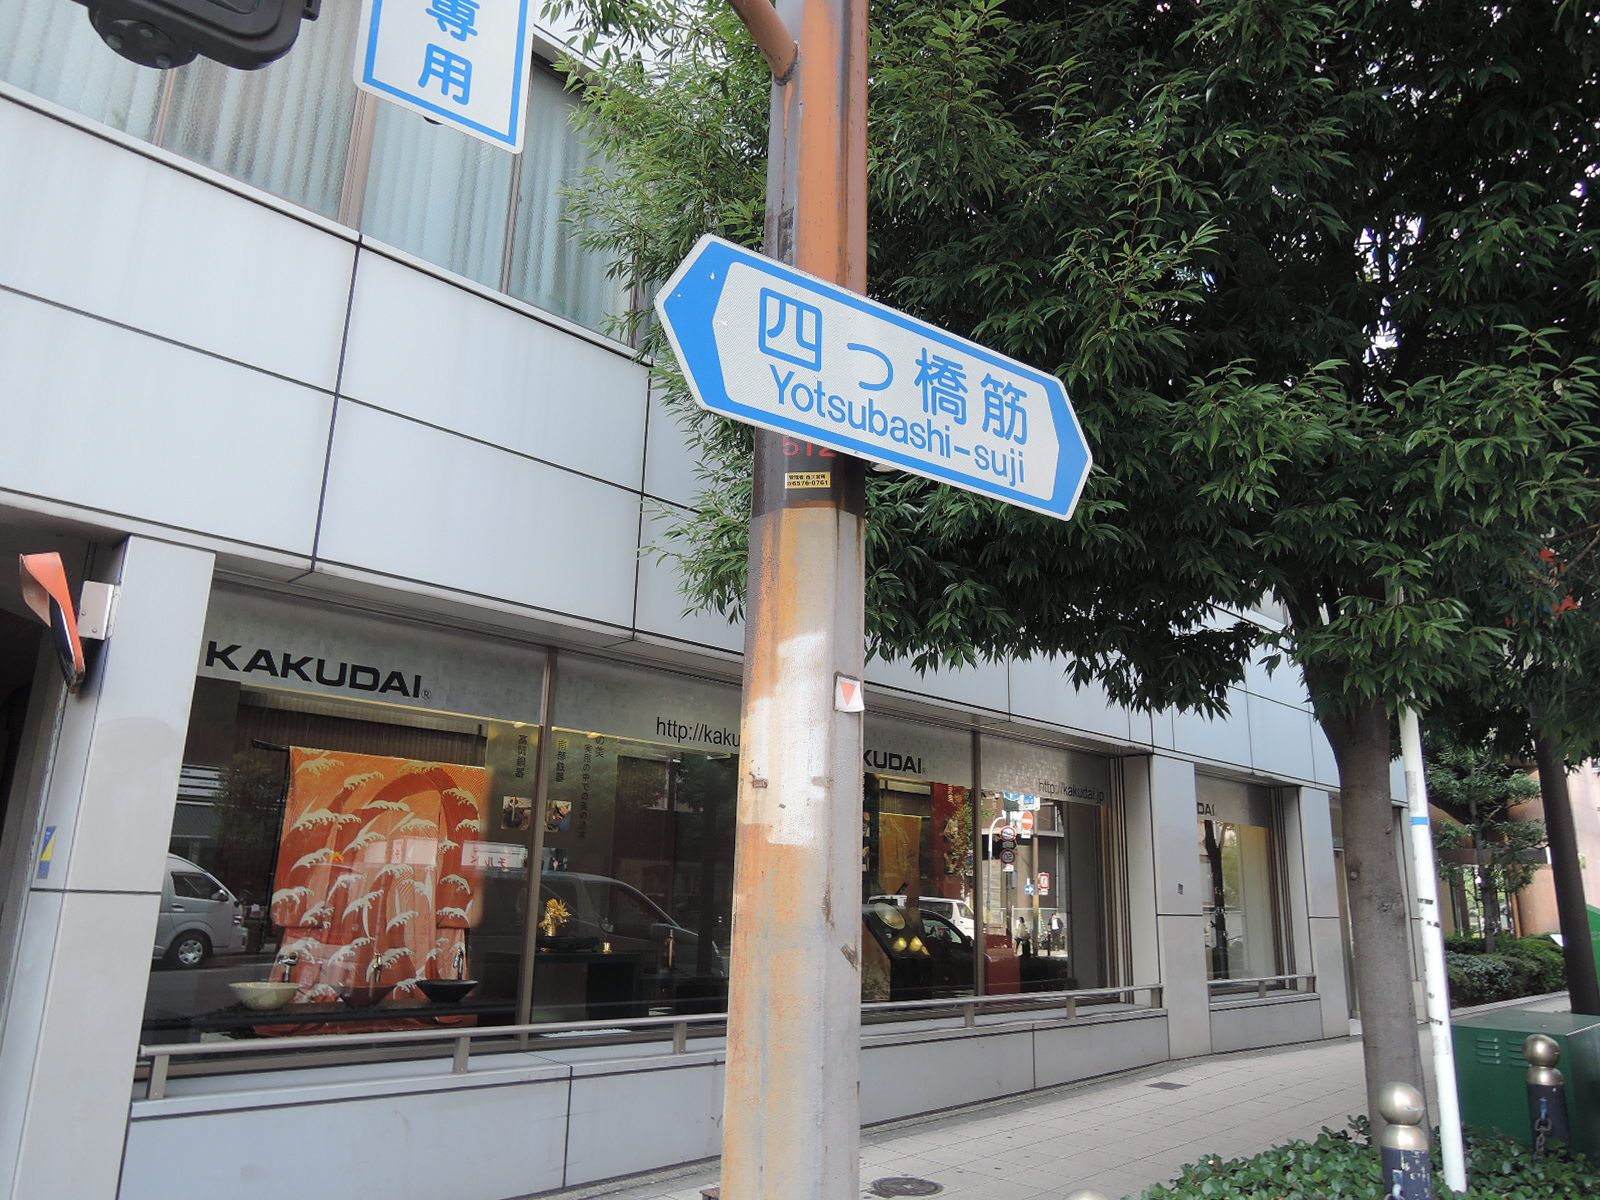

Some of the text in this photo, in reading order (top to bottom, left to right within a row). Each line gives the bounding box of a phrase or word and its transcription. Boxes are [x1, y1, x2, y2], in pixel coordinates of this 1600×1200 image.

[418, 0, 480, 105] 専用
[758, 287, 1029, 446] 四つ橋筋
[769, 364, 1026, 487] Yotsubashi-suji
[206, 641, 422, 699] KAKUDAI
